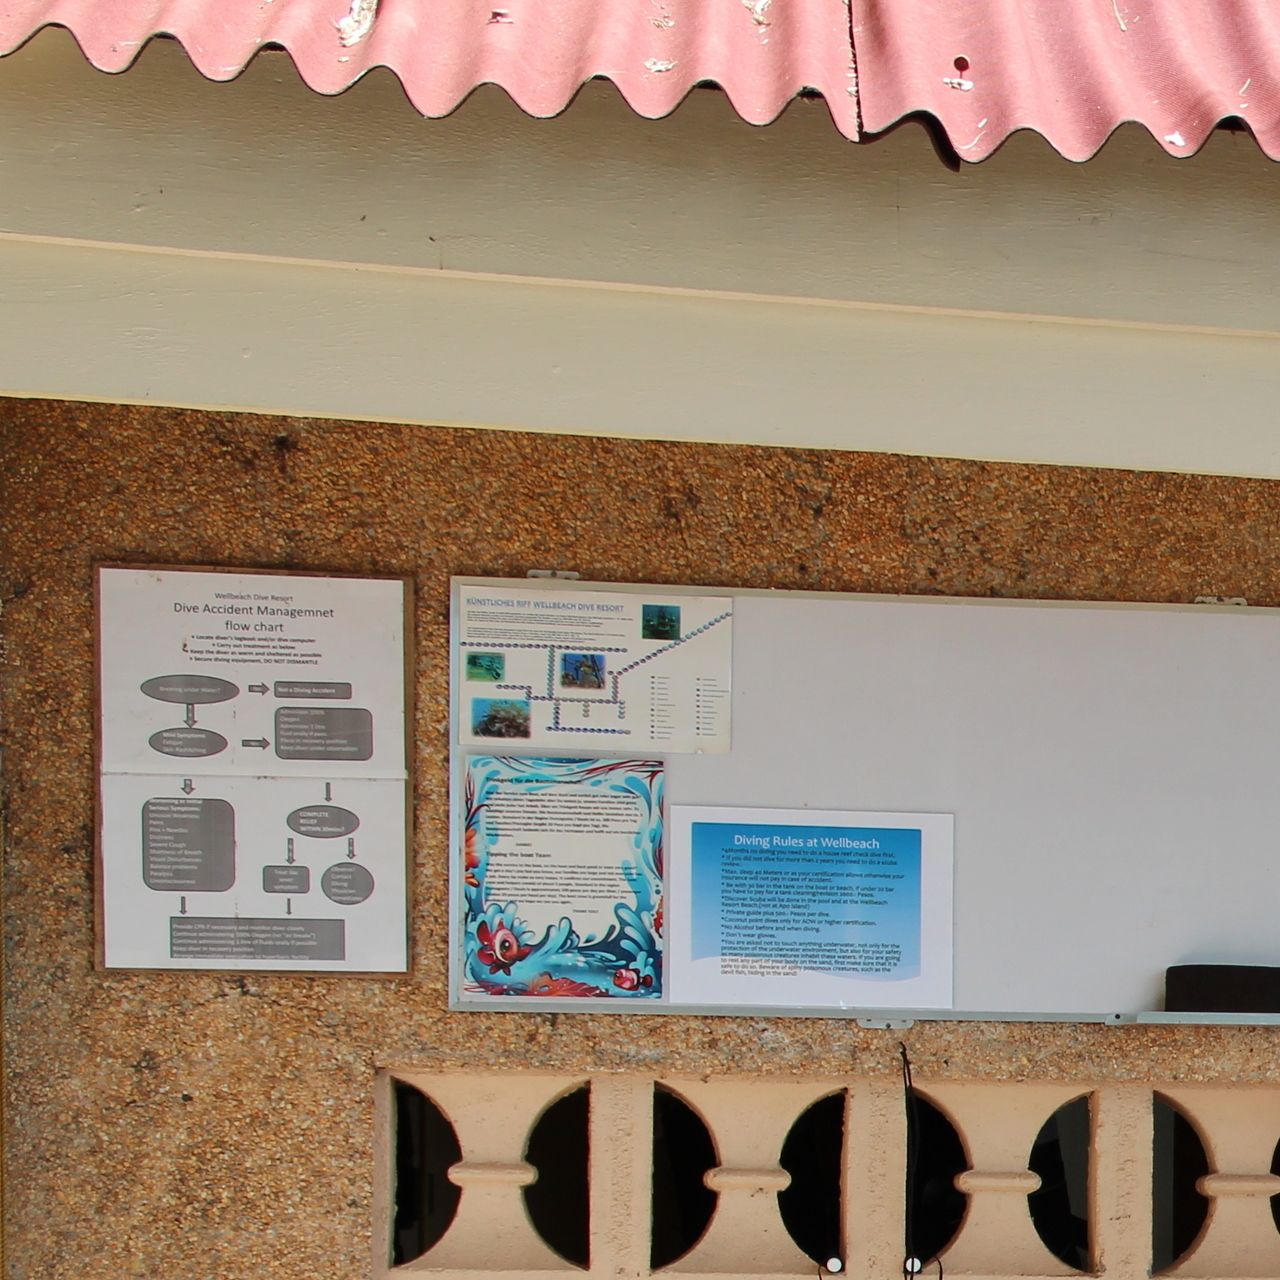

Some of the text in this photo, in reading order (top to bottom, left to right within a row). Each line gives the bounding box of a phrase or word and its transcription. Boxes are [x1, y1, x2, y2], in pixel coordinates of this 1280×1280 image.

[214, 592, 293, 602] Wellbeach Dive Resort
[174, 603, 334, 619] Dive Accident Managemnet
[466, 598, 624, 613] KÜNSTLICHES RIFF WELLBEACH DIVE RESORT
[225, 620, 283, 632] flow chart
[734, 834, 880, 849] Diving Rules at Wellbeach
